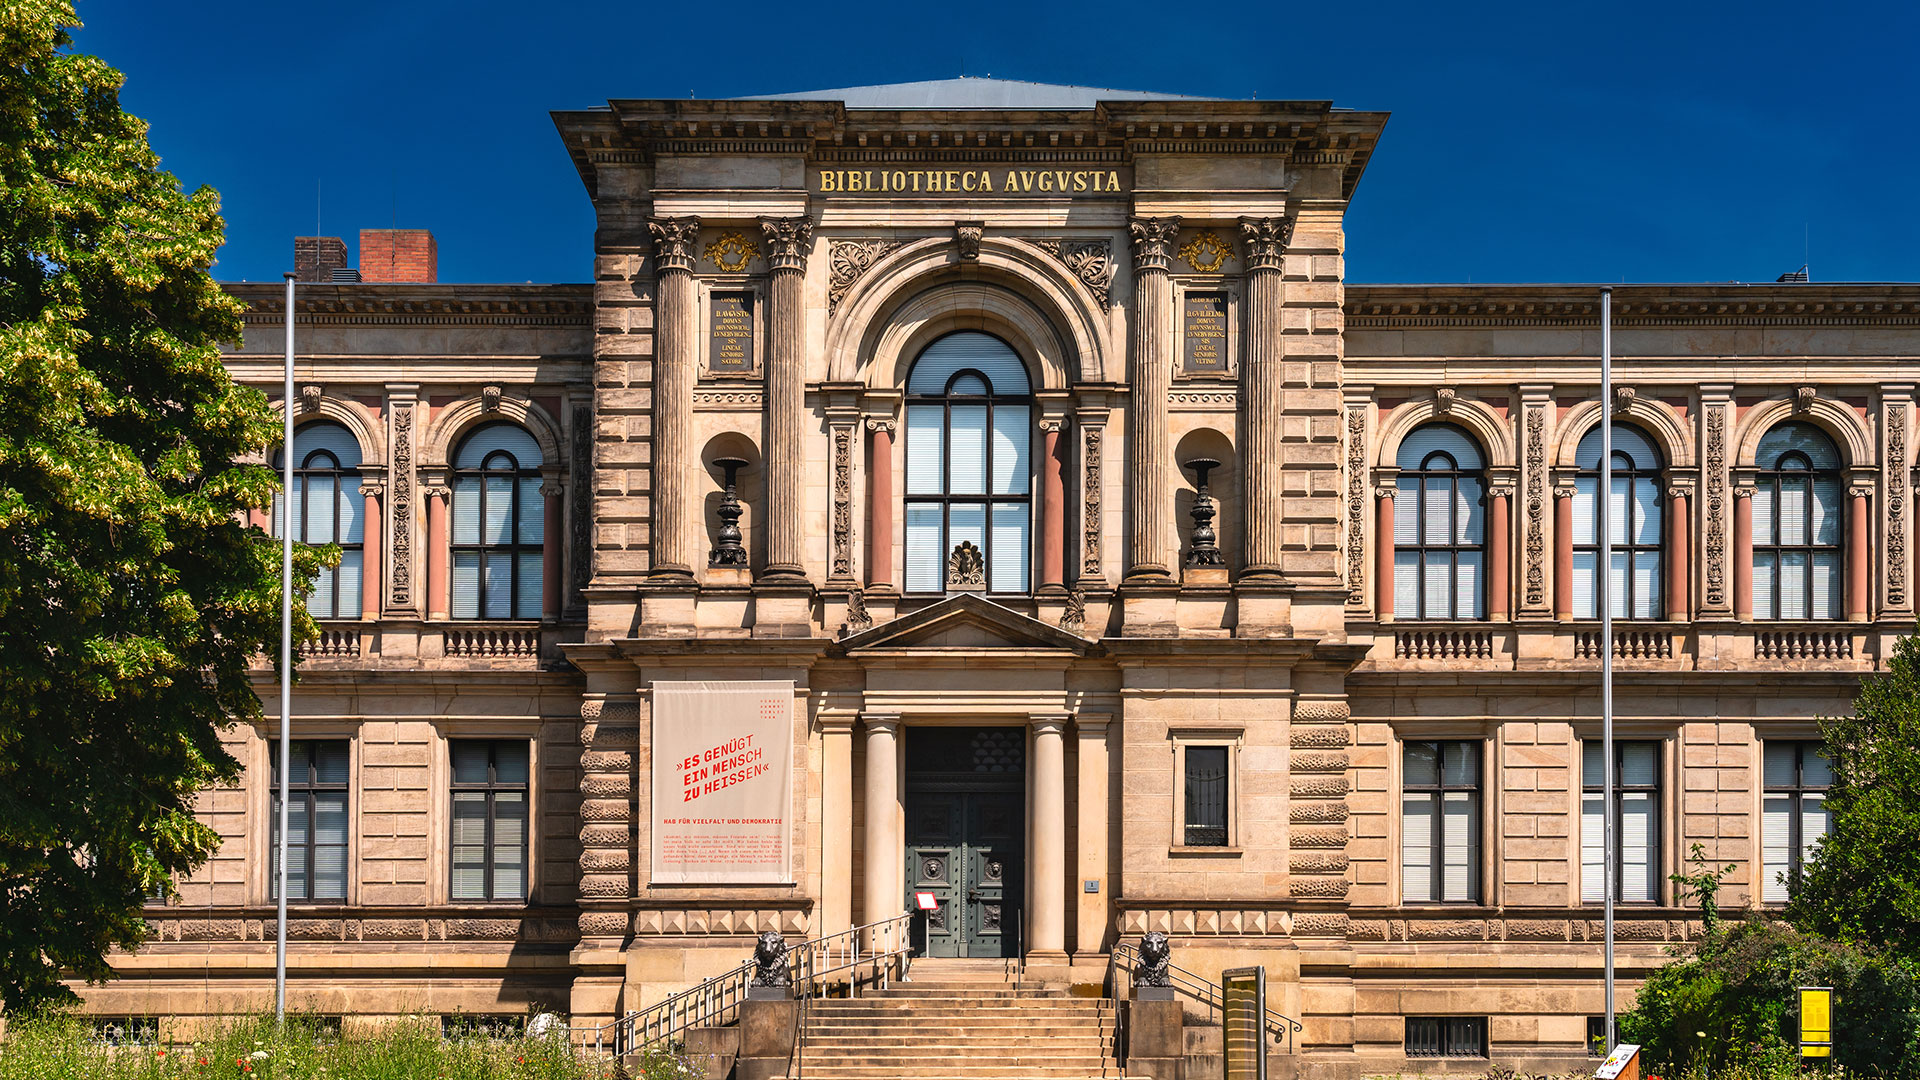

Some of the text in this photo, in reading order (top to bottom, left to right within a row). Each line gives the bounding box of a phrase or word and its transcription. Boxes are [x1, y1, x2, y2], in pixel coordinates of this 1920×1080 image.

[819, 170, 1121, 192] BIBLIOTHECA AVGVSTA
[704, 734, 754, 762] GENÜGT
[684, 747, 762, 786] EIN MENSCH
[684, 786, 700, 802] ZU
